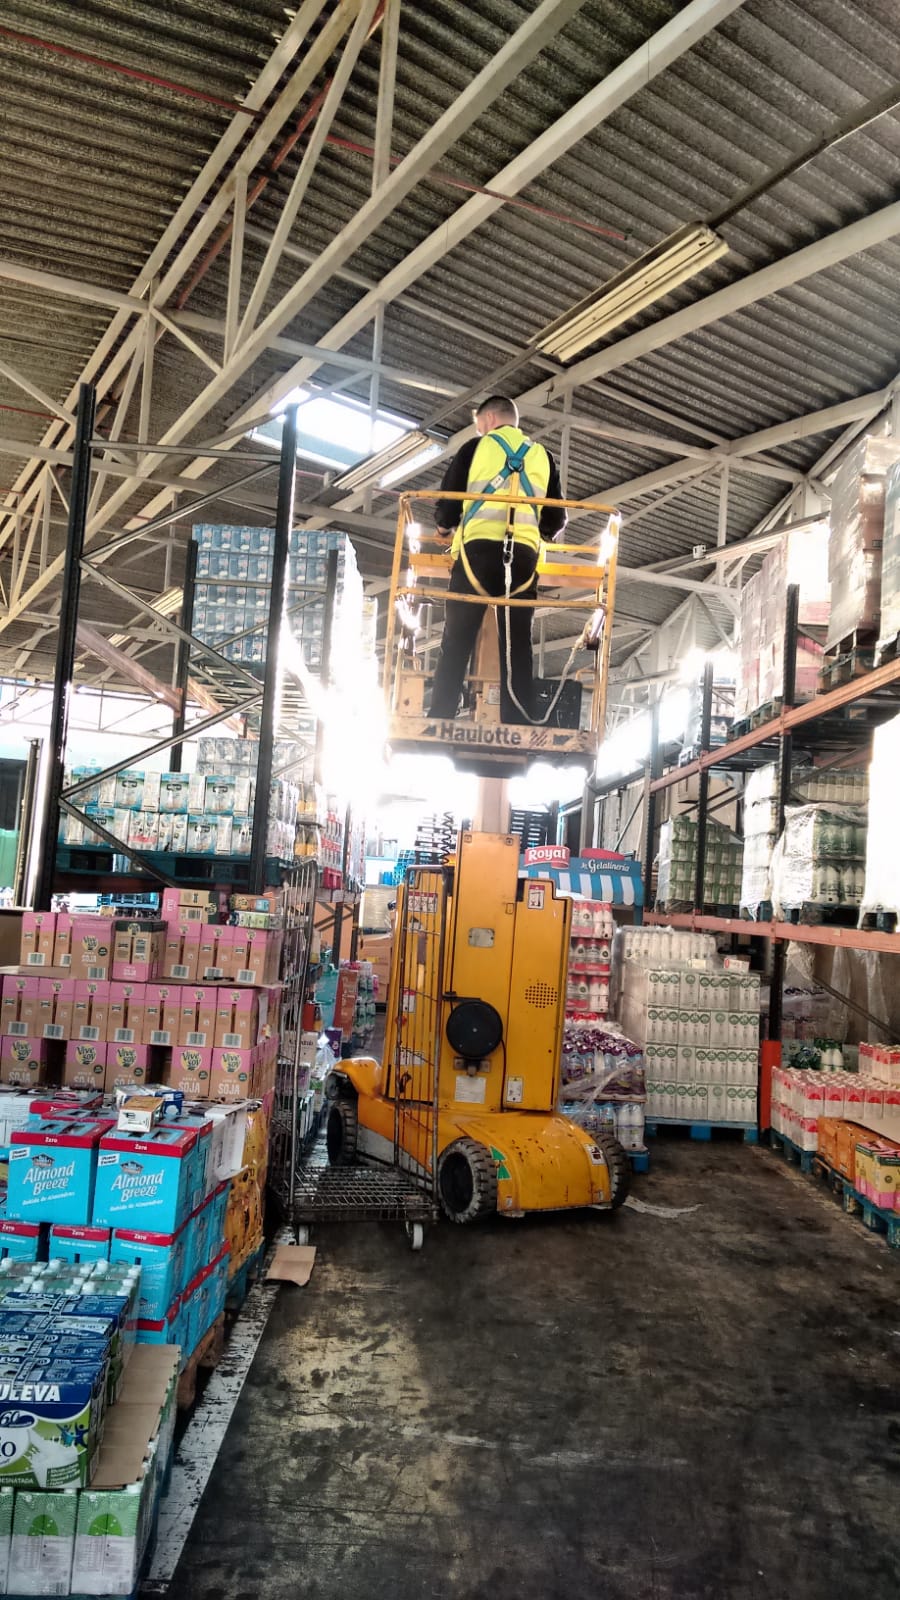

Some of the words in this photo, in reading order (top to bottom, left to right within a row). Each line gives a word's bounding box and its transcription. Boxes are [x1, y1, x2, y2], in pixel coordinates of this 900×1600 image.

[440, 721, 522, 746] Haulotte
[528, 848, 566, 861] Royal
[217, 1083, 240, 1095] SOJA
[134, 1143, 148, 1151] Zero
[22, 1160, 75, 1185] Almond
[110, 1169, 164, 1191] Almond
[33, 1177, 69, 1196] Breeze
[120, 1184, 158, 1203] Breeze
[71, 1229, 85, 1237] Zero
[133, 1233, 147, 1241] Zero
